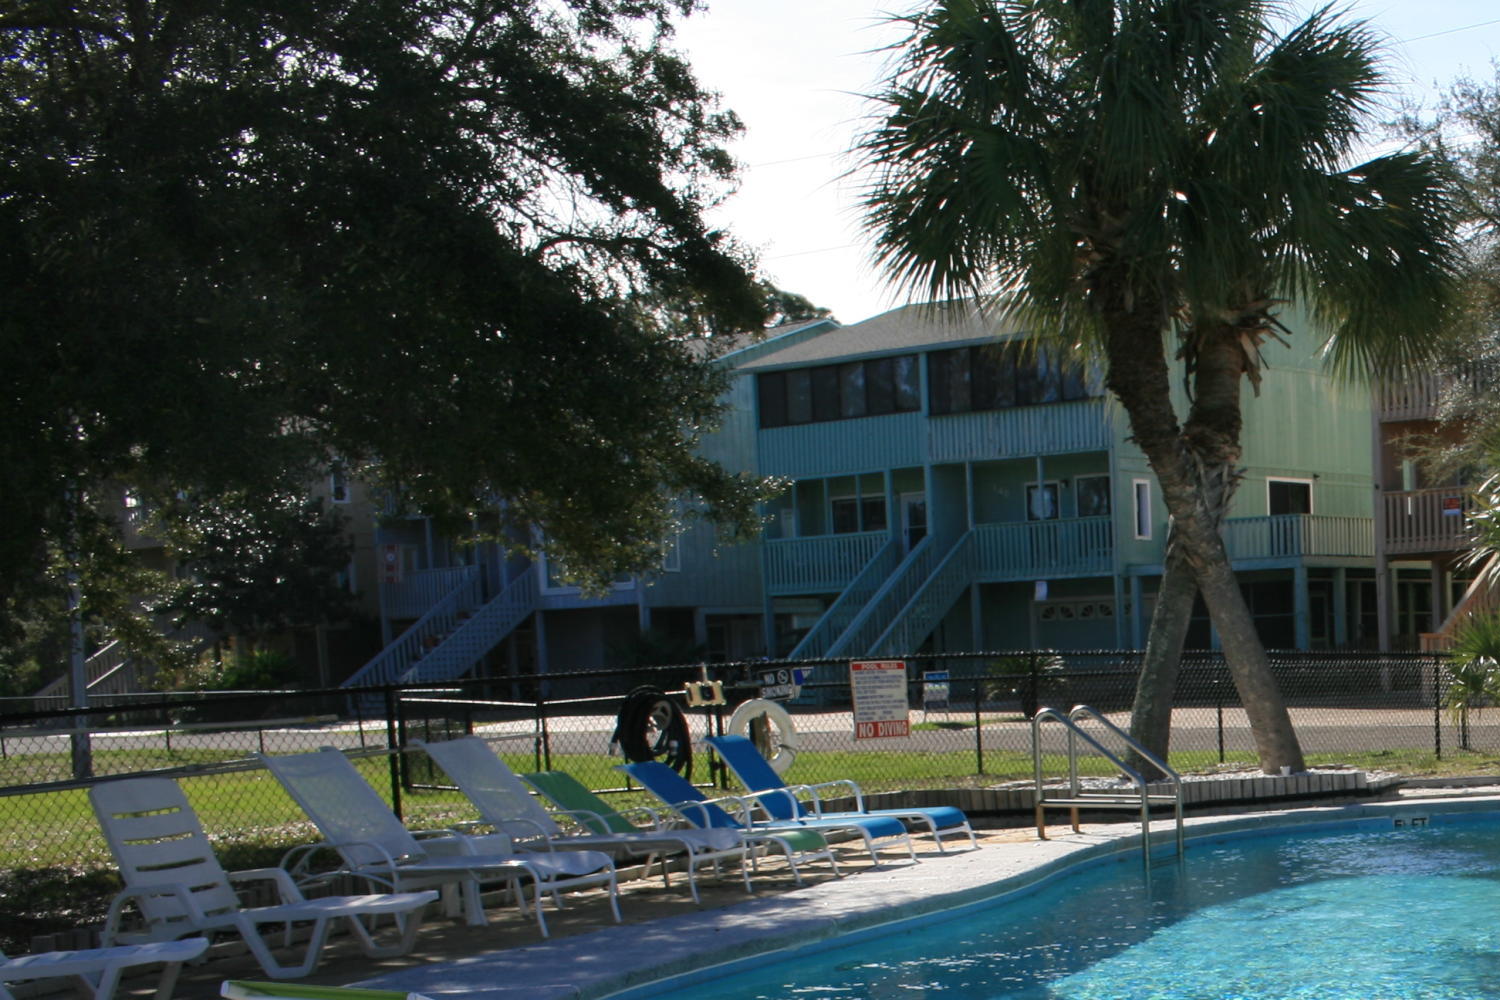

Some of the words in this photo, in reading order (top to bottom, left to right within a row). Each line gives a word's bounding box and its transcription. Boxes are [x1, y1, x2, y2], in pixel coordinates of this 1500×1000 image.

[763, 672, 776, 685] NO
[859, 722, 874, 737] NO
[878, 721, 907, 736] DIVING
